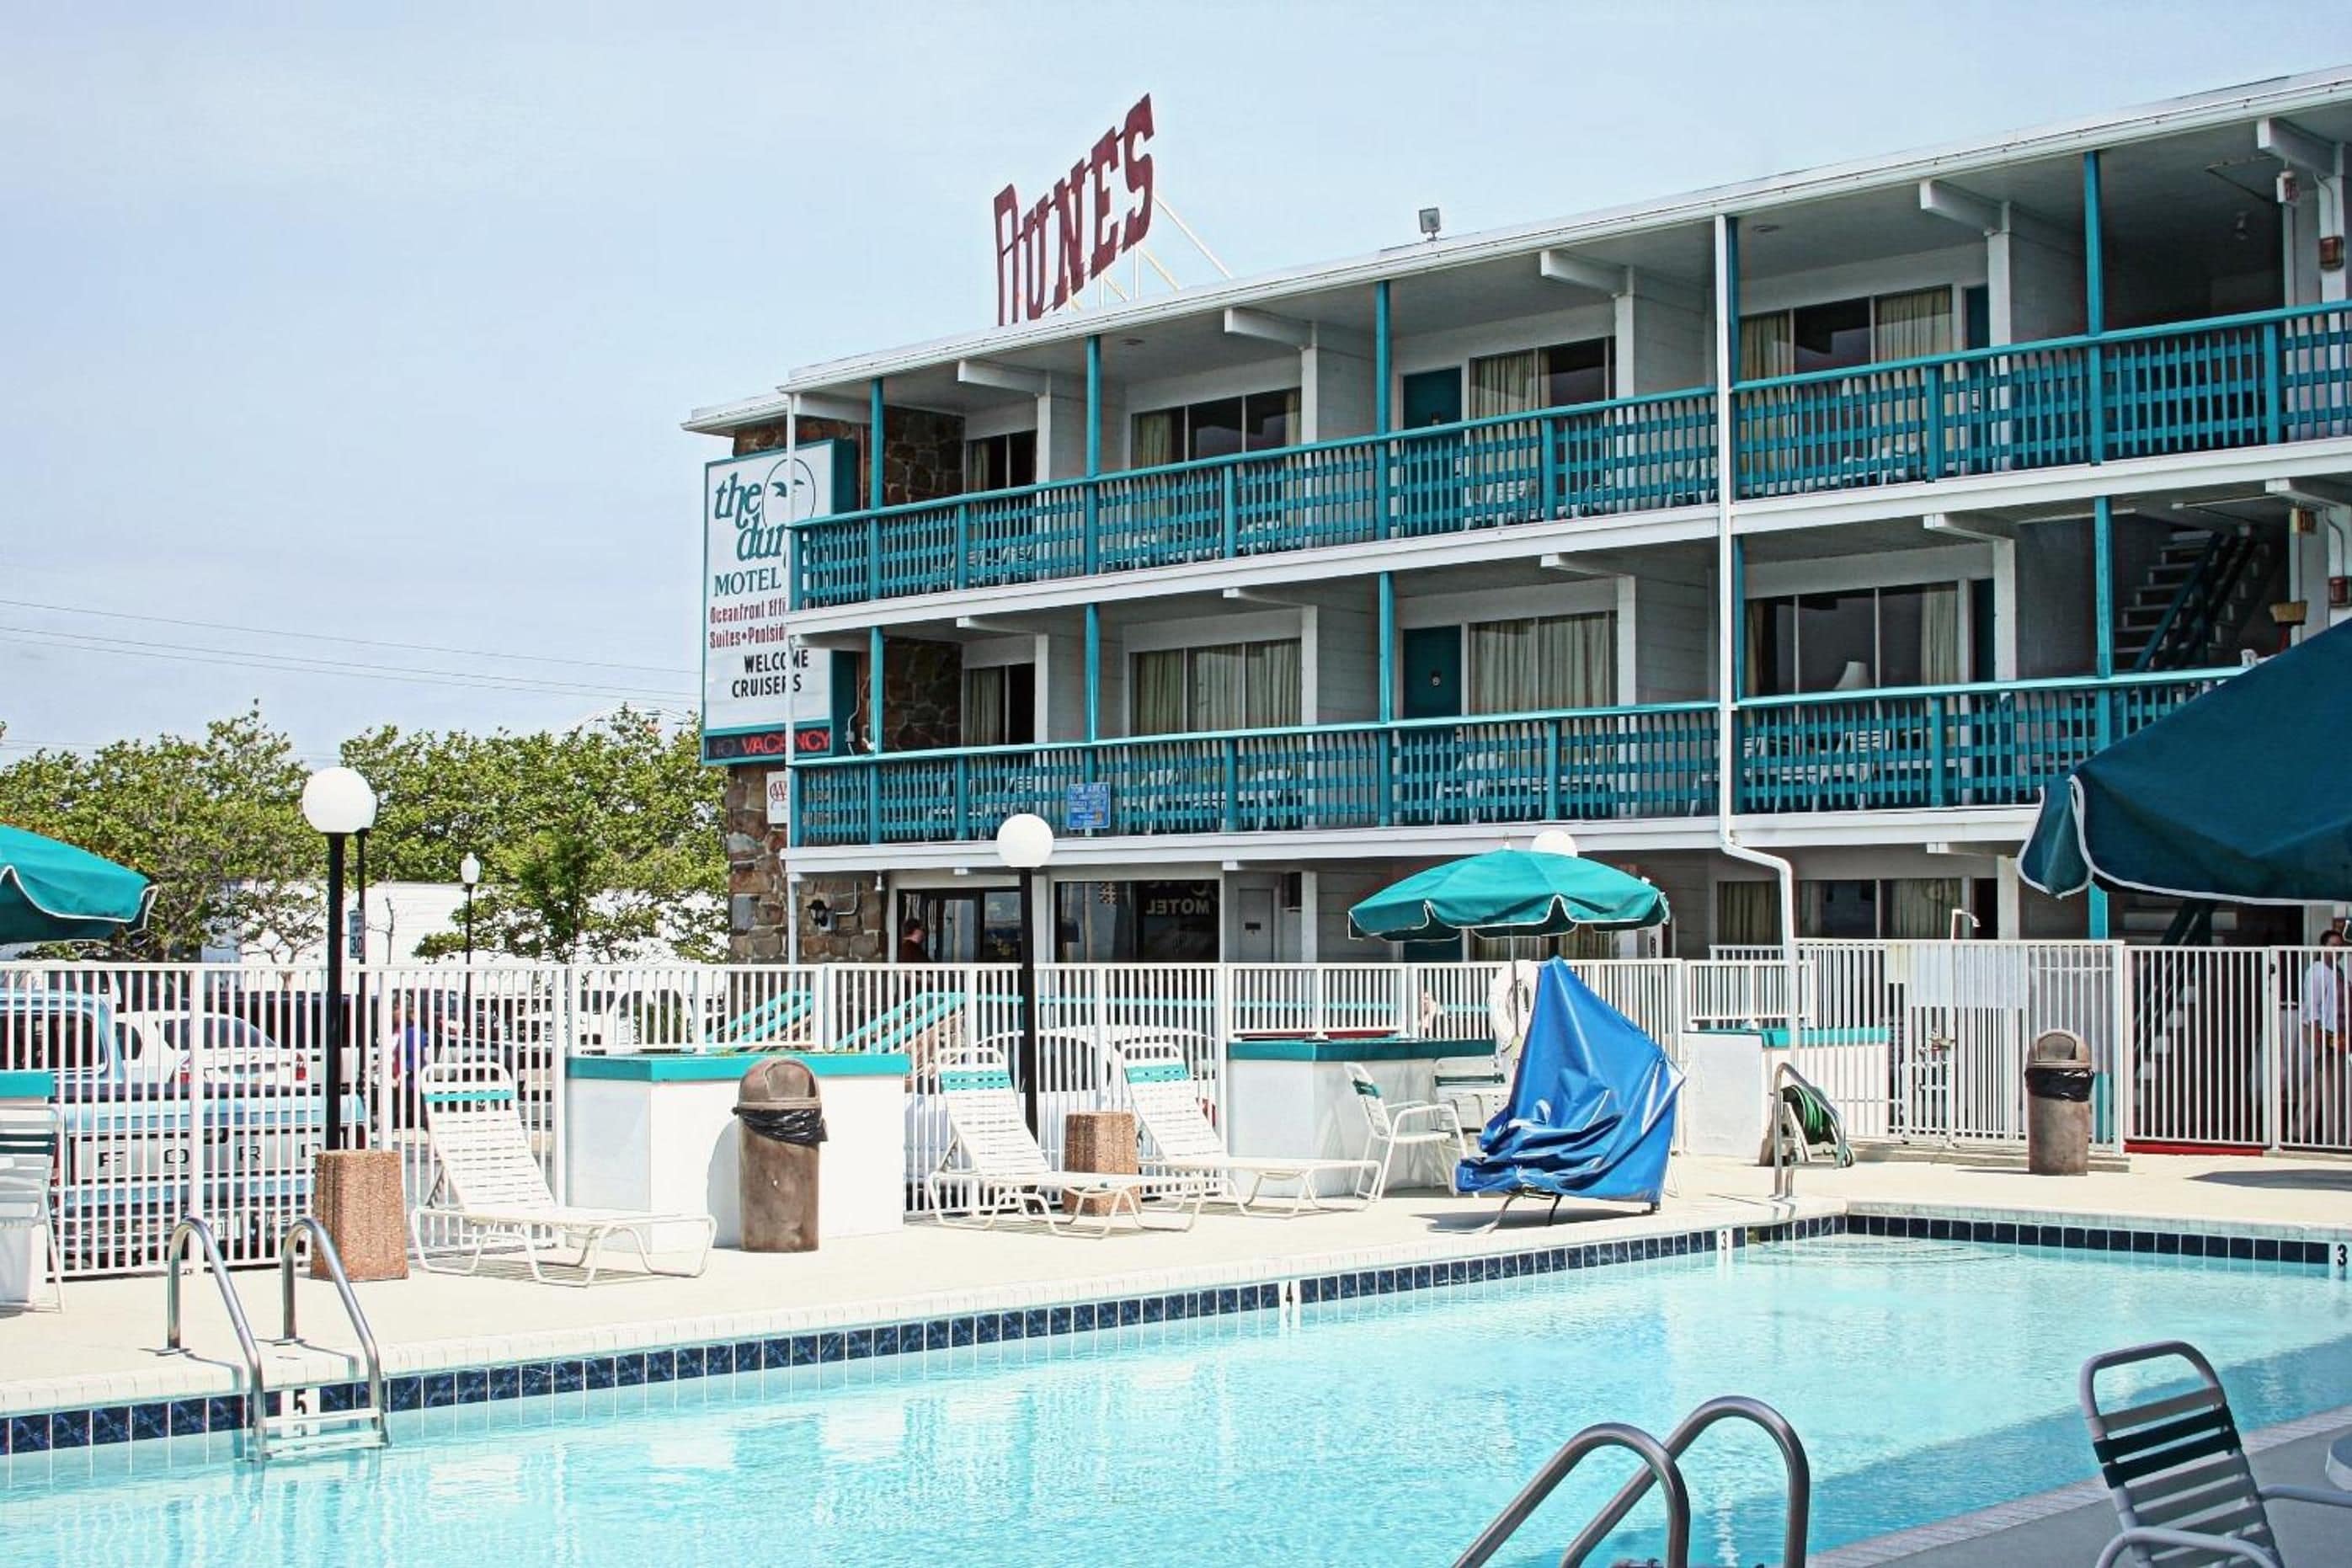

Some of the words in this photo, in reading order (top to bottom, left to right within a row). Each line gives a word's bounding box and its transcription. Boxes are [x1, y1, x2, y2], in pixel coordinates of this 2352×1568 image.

[714, 472, 763, 530] the
[714, 567, 781, 596] MOTEL
[710, 599, 765, 624] Oceanfront
[1720, 1229, 1727, 1251] 3
[2337, 1243, 2348, 1267] 3
[293, 1388, 307, 1416] 5
